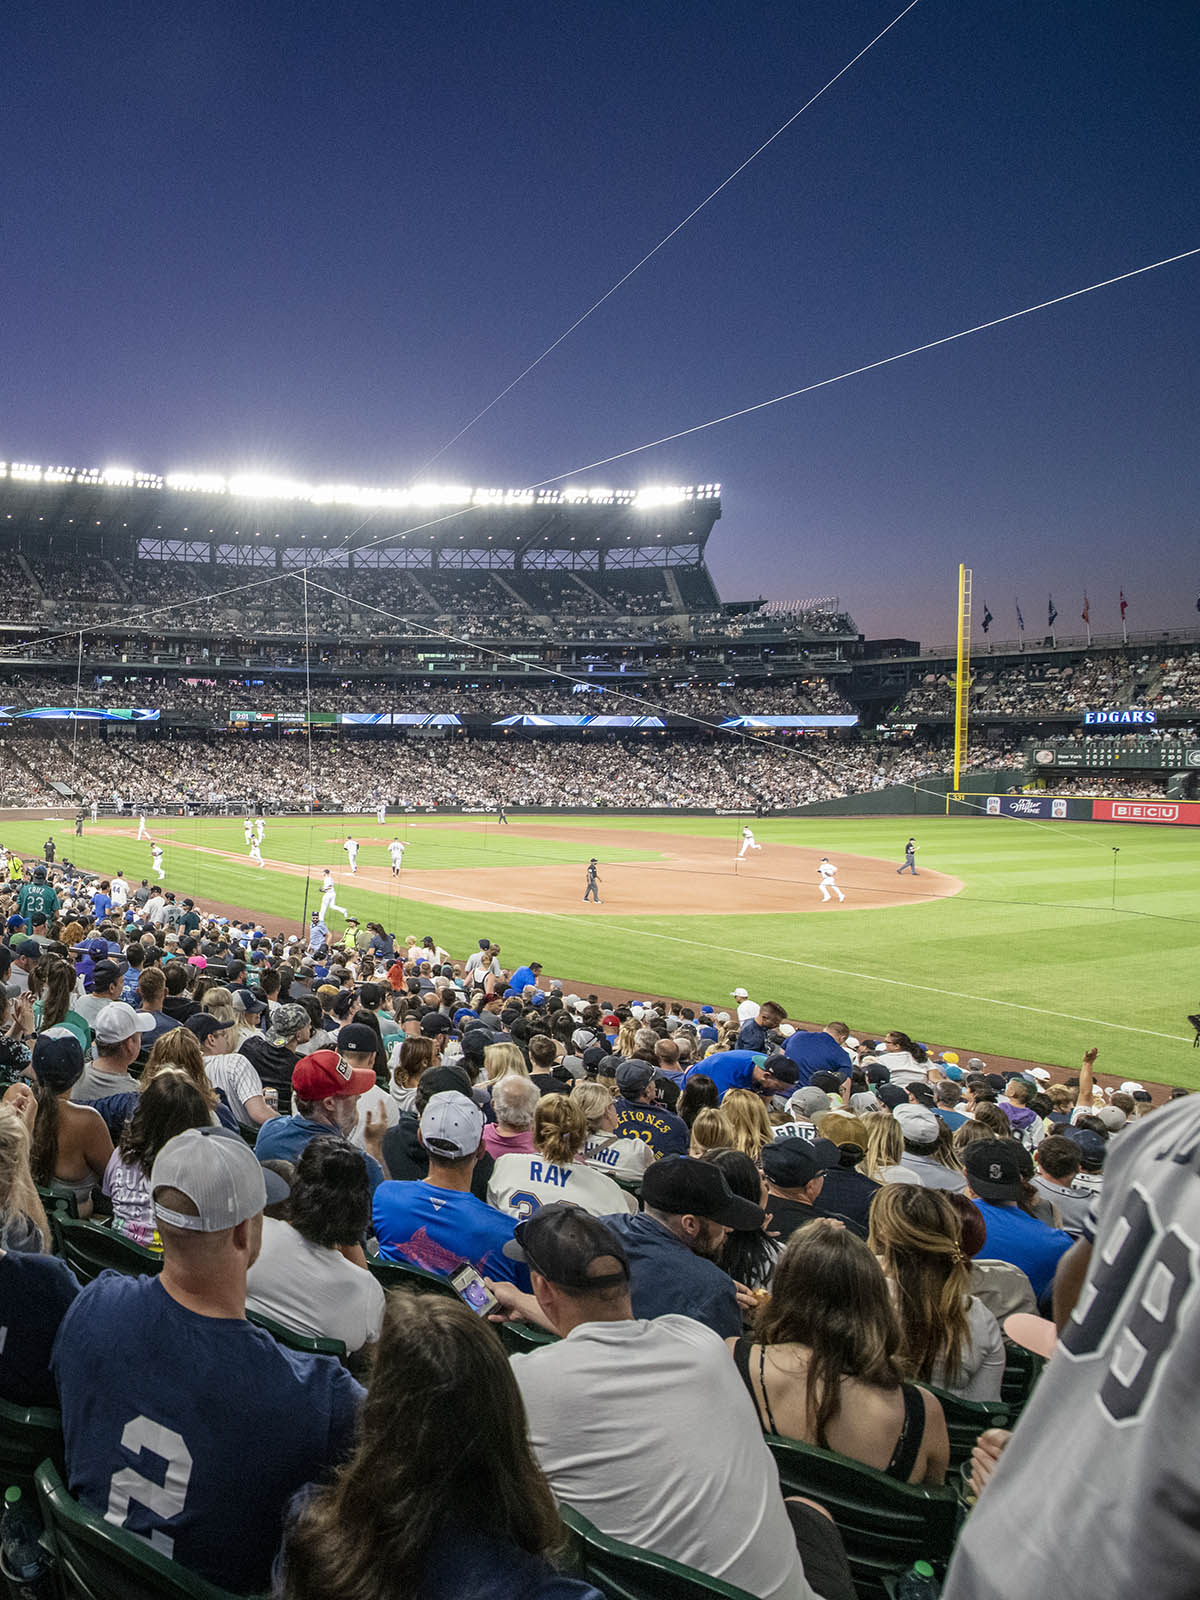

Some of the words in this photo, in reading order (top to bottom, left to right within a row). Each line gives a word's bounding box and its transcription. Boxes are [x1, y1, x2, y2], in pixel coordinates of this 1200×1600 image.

[28, 886, 46, 895] CRUZ
[26, 895, 44, 912] 23
[615, 1110, 673, 1134] EFTONES
[530, 1161, 573, 1188] RAY
[105, 1415, 194, 1560] 2
